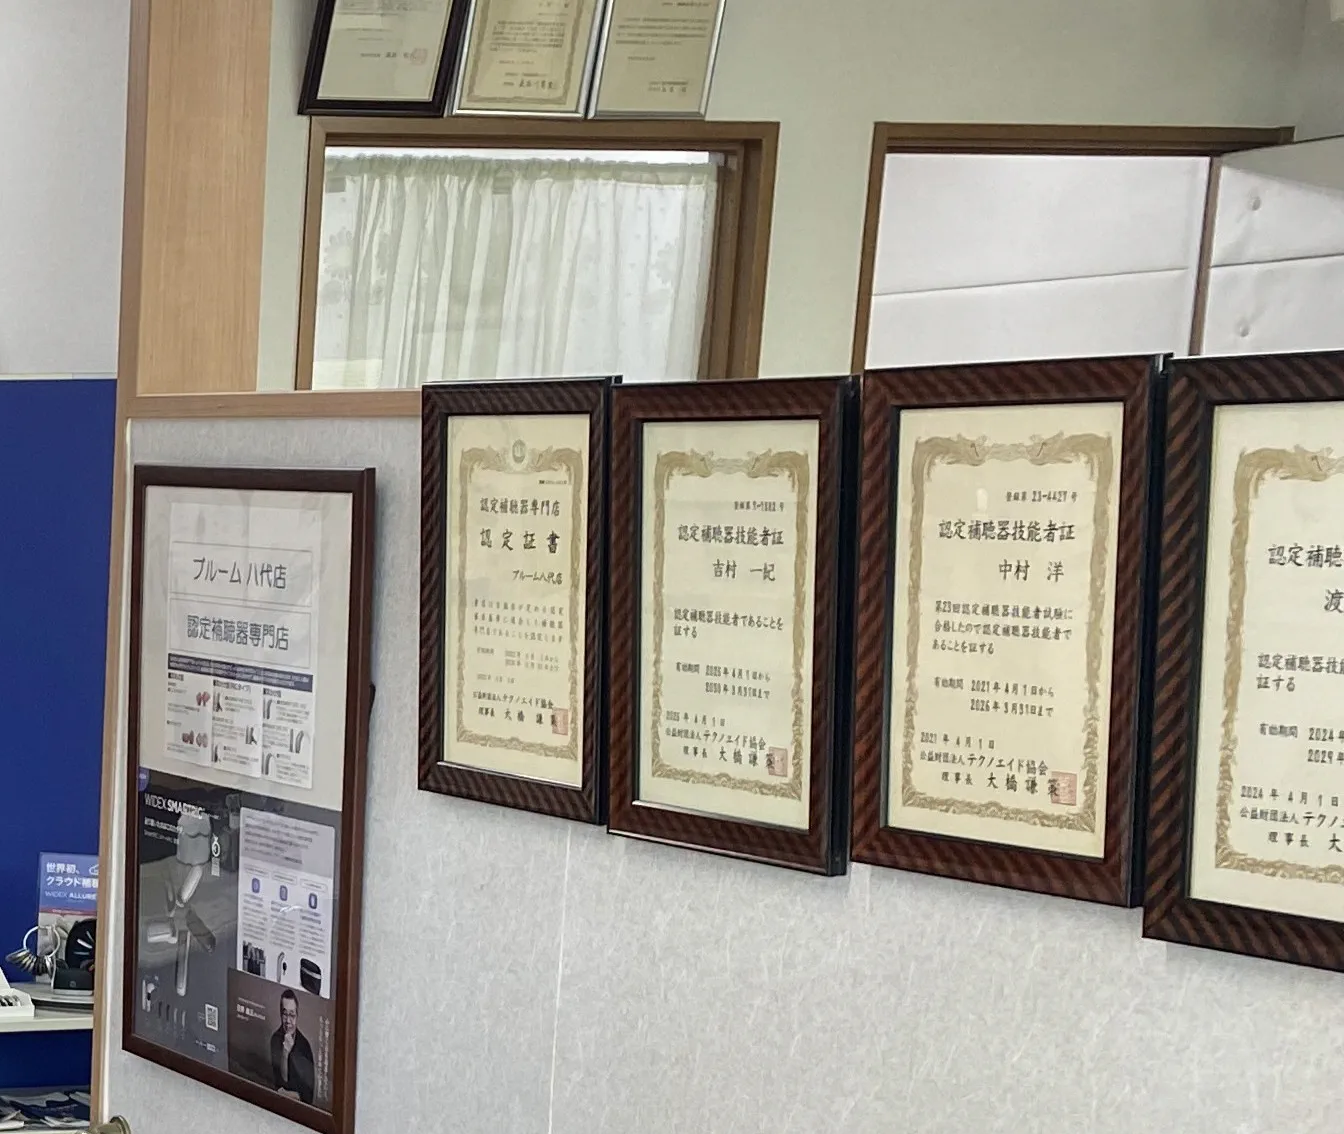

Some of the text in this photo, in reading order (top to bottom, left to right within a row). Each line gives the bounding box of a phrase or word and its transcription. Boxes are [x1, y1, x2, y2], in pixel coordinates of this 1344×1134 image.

[480, 528, 560, 554] 認定証書
[678, 523, 785, 547] 認定補聴器技能者証
[938, 518, 1076, 543] 認定補聴器技能者証
[193, 557, 287, 589] ブルーム 八代店
[713, 559, 737, 579] 吉村
[998, 558, 1064, 583] 中村 洋
[187, 614, 289, 651] 認定補聴器専門店
[1256, 674, 1296, 692] 証する
